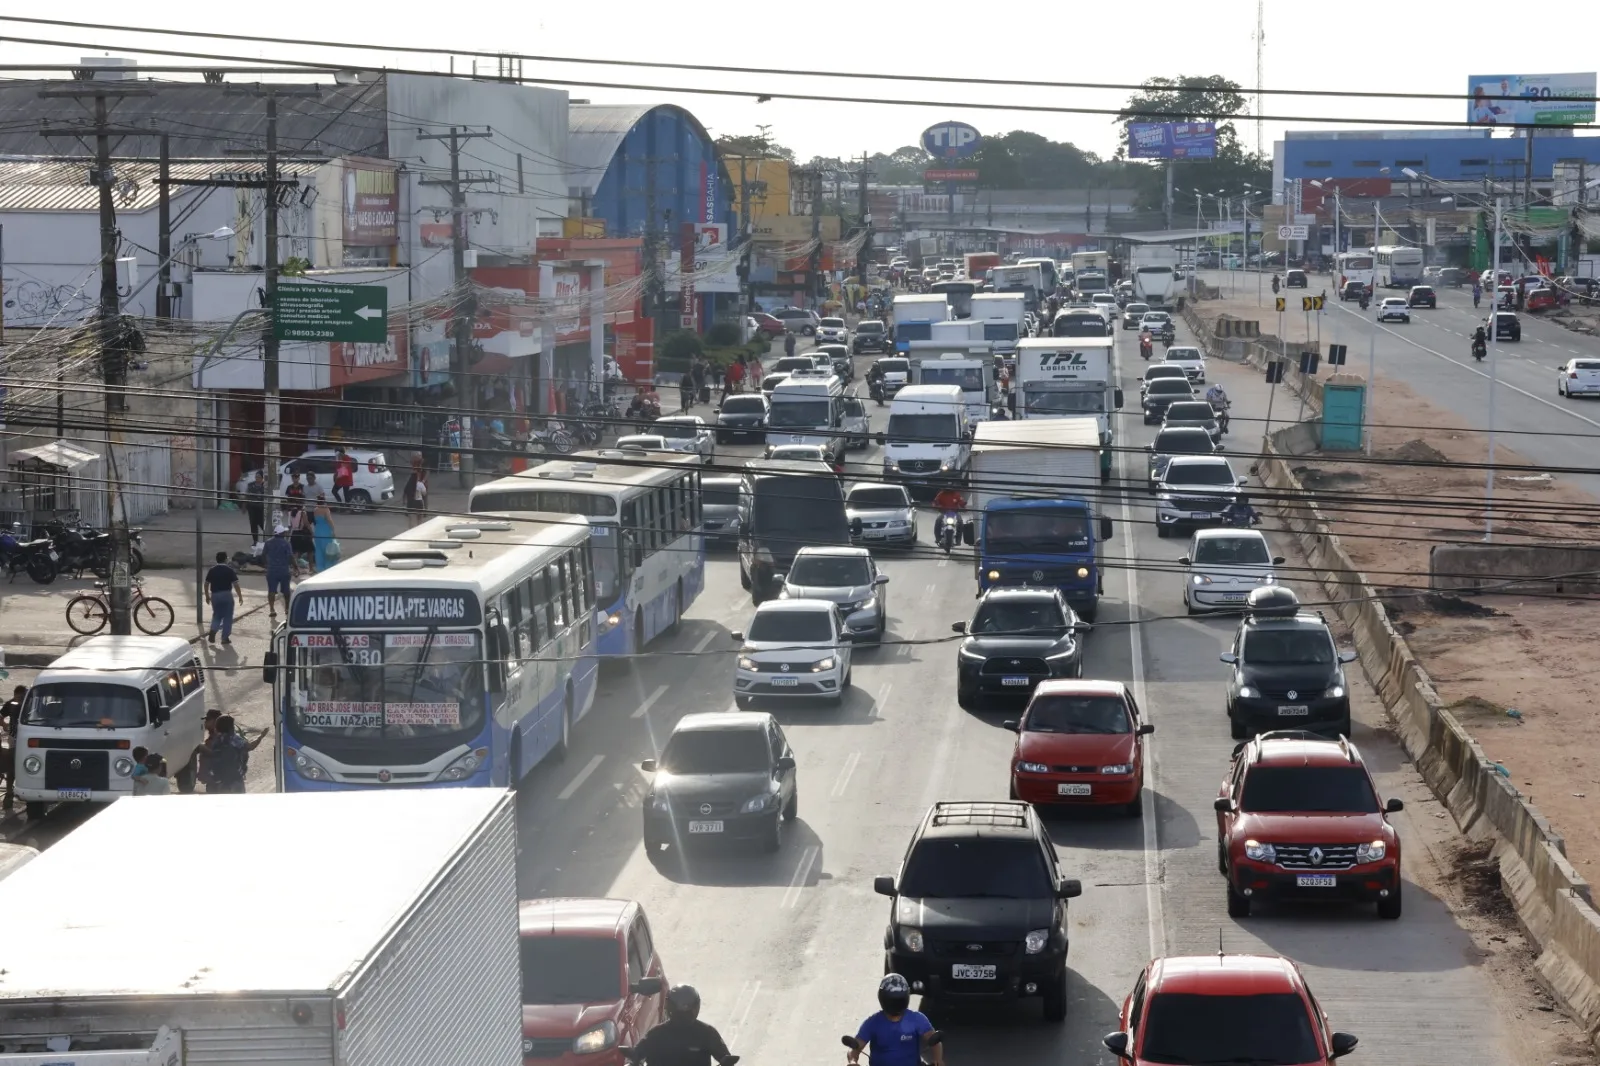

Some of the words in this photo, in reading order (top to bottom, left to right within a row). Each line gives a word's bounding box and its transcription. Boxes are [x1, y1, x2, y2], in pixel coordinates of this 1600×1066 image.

[930, 126, 976, 147] TIP
[706, 173, 715, 225] ASASBAHIA
[1039, 353, 1088, 366] TPL
[307, 635, 369, 647] BRACAS
[304, 715, 332, 726] DOCA
